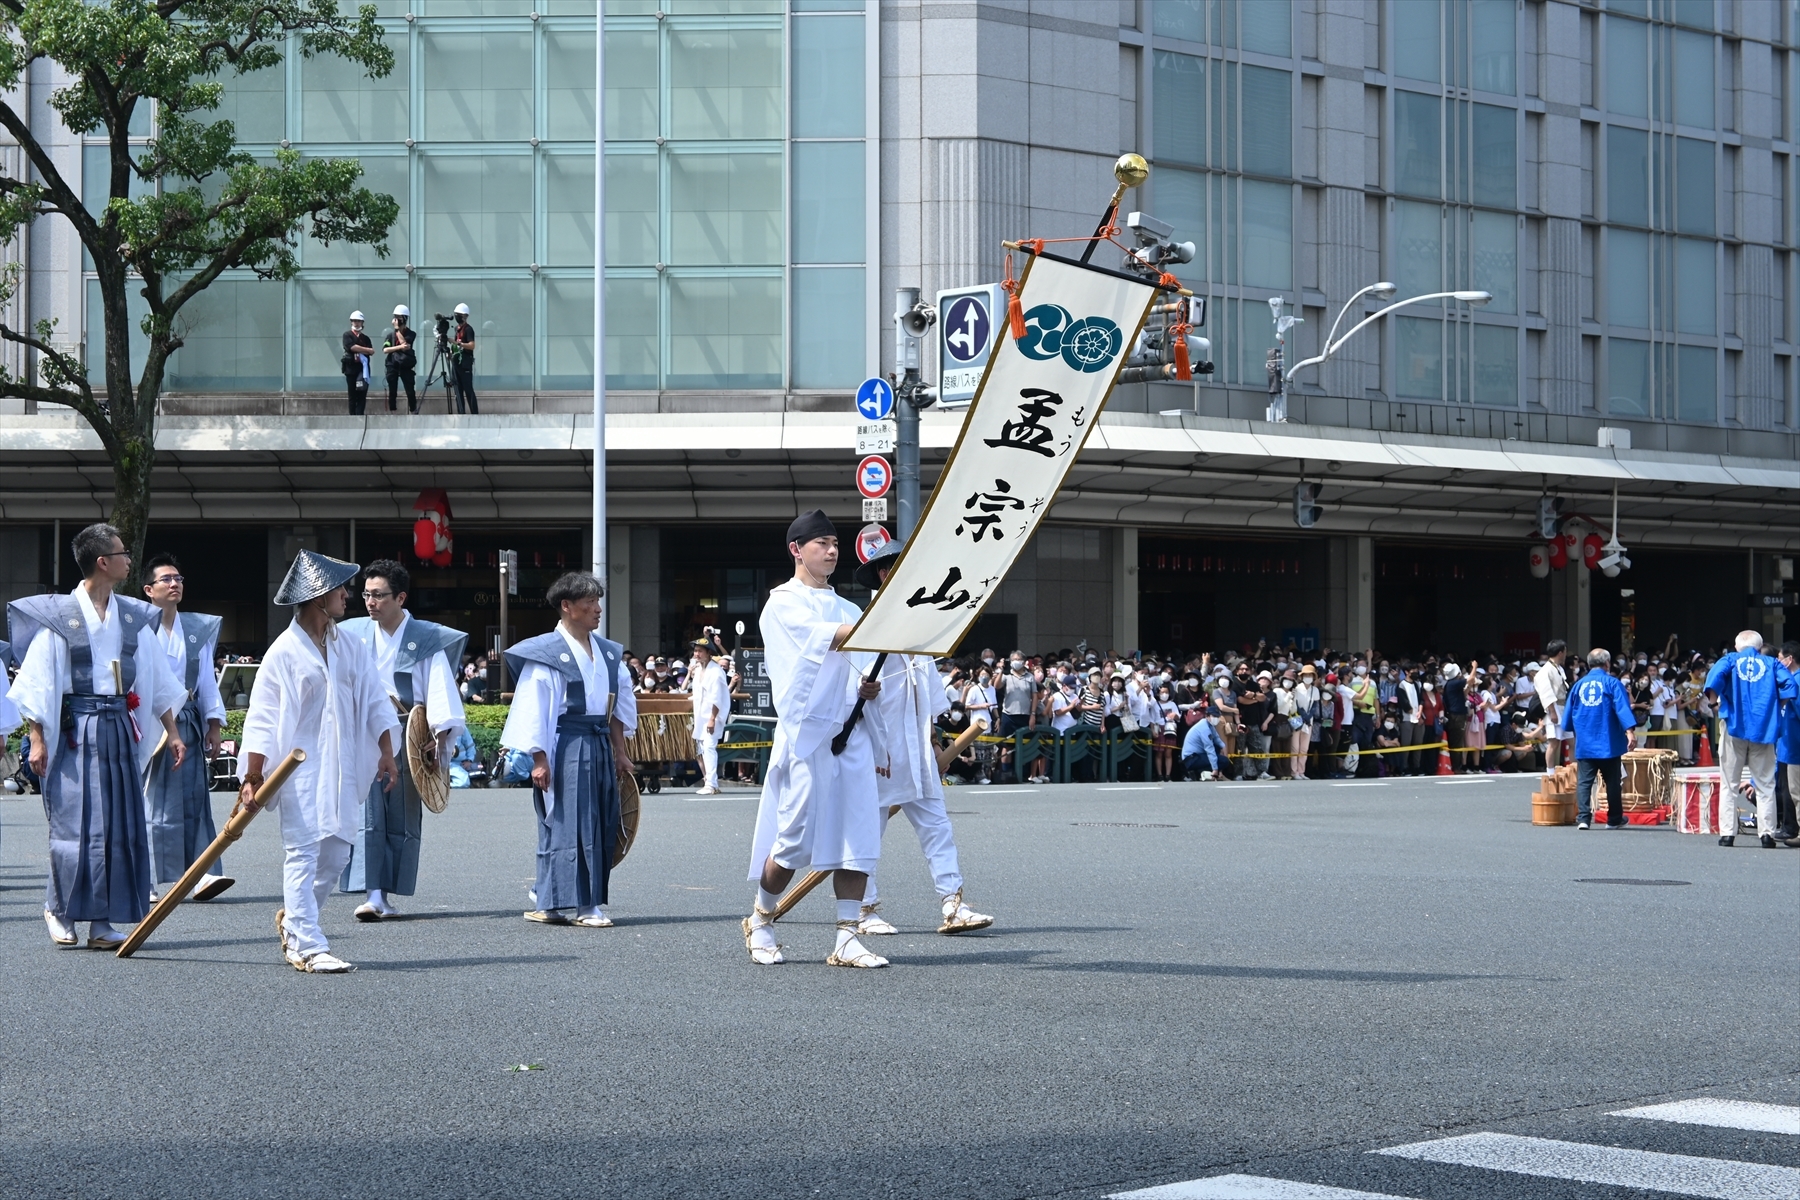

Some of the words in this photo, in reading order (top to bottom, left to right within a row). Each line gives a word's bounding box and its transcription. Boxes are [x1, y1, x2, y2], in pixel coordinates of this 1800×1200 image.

[857, 423, 892, 435] 路線バスを除く
[906, 388, 1064, 611] 孟宗山
